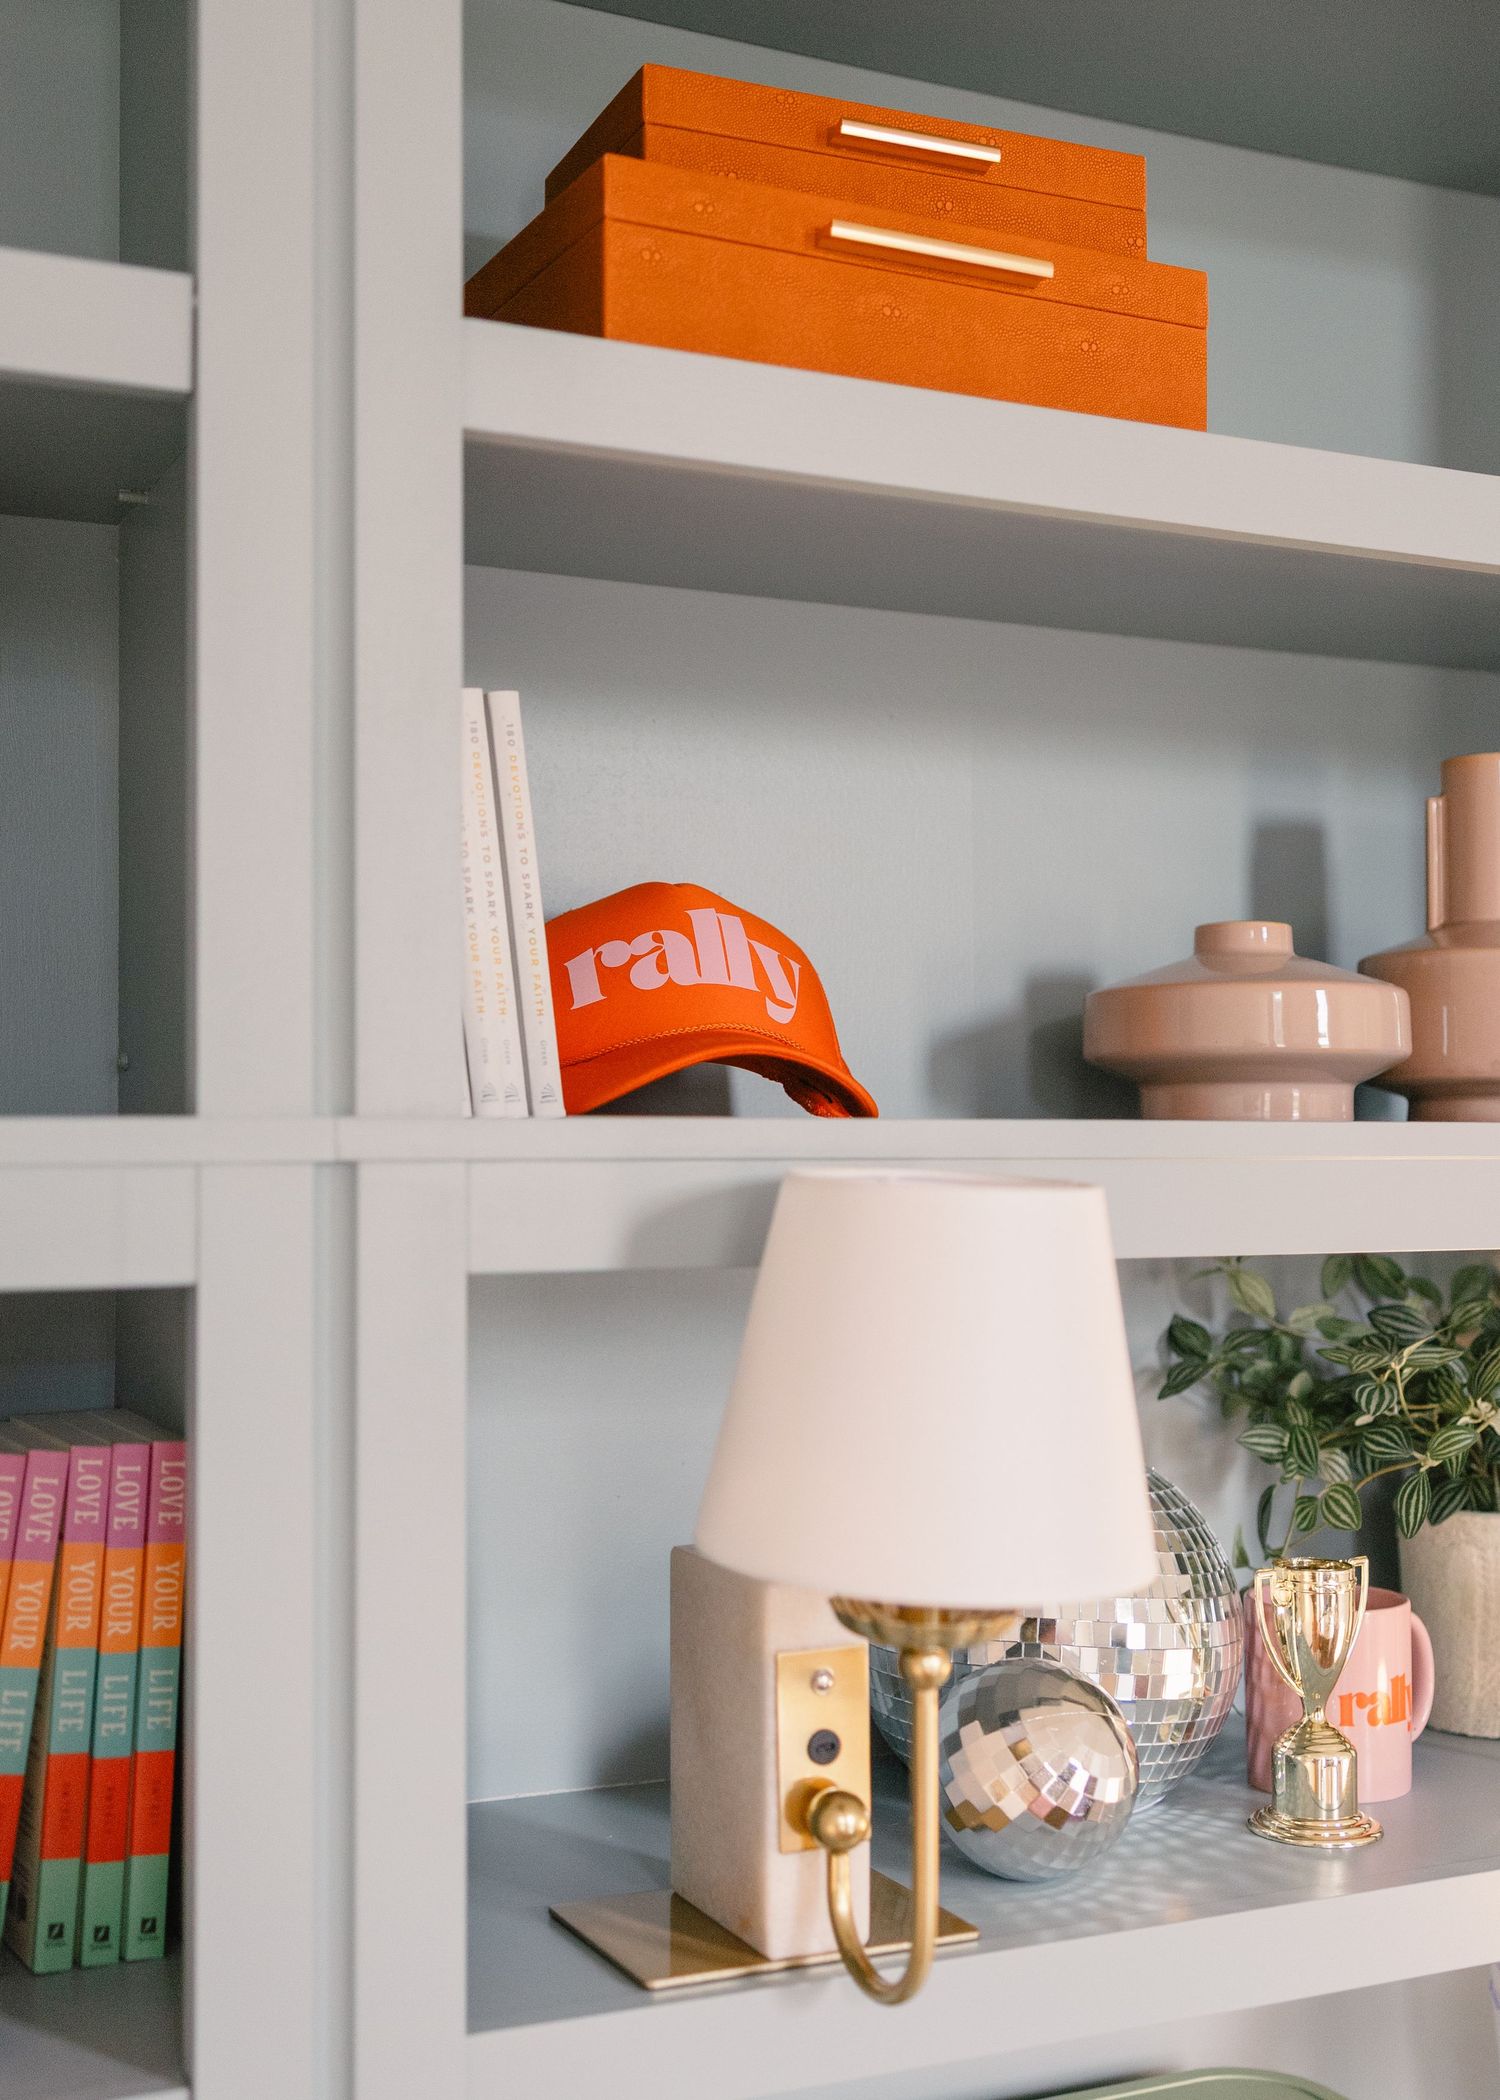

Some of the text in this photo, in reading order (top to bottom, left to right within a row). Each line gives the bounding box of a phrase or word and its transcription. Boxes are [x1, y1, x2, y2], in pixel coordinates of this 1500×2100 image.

[469, 720, 479, 744] 180
[505, 723, 516, 747] 180
[472, 752, 488, 838] DEVOTIONS
[509, 754, 526, 840] DEVOTIONS
[482, 846, 491, 863] TO
[519, 848, 528, 865] TO
[462, 867, 475, 914] SPARK
[485, 871, 496, 918] SPARK
[522, 873, 534, 919] SPARK
[468, 922, 480, 962] YOUR
[491, 926, 502, 965] YOUR
[528, 928, 540, 966] YOUR
[563, 908, 801, 1024] rally
[25, 1476, 59, 1543] LOVE
[10, 1579, 45, 1650] YOUR
[57, 1459, 103, 1732] LOVE YOUR LIFE
[101, 1465, 141, 1736] LOVE YOUR LIFE
[147, 1460, 186, 1730] LOVE YOUR LIFE
